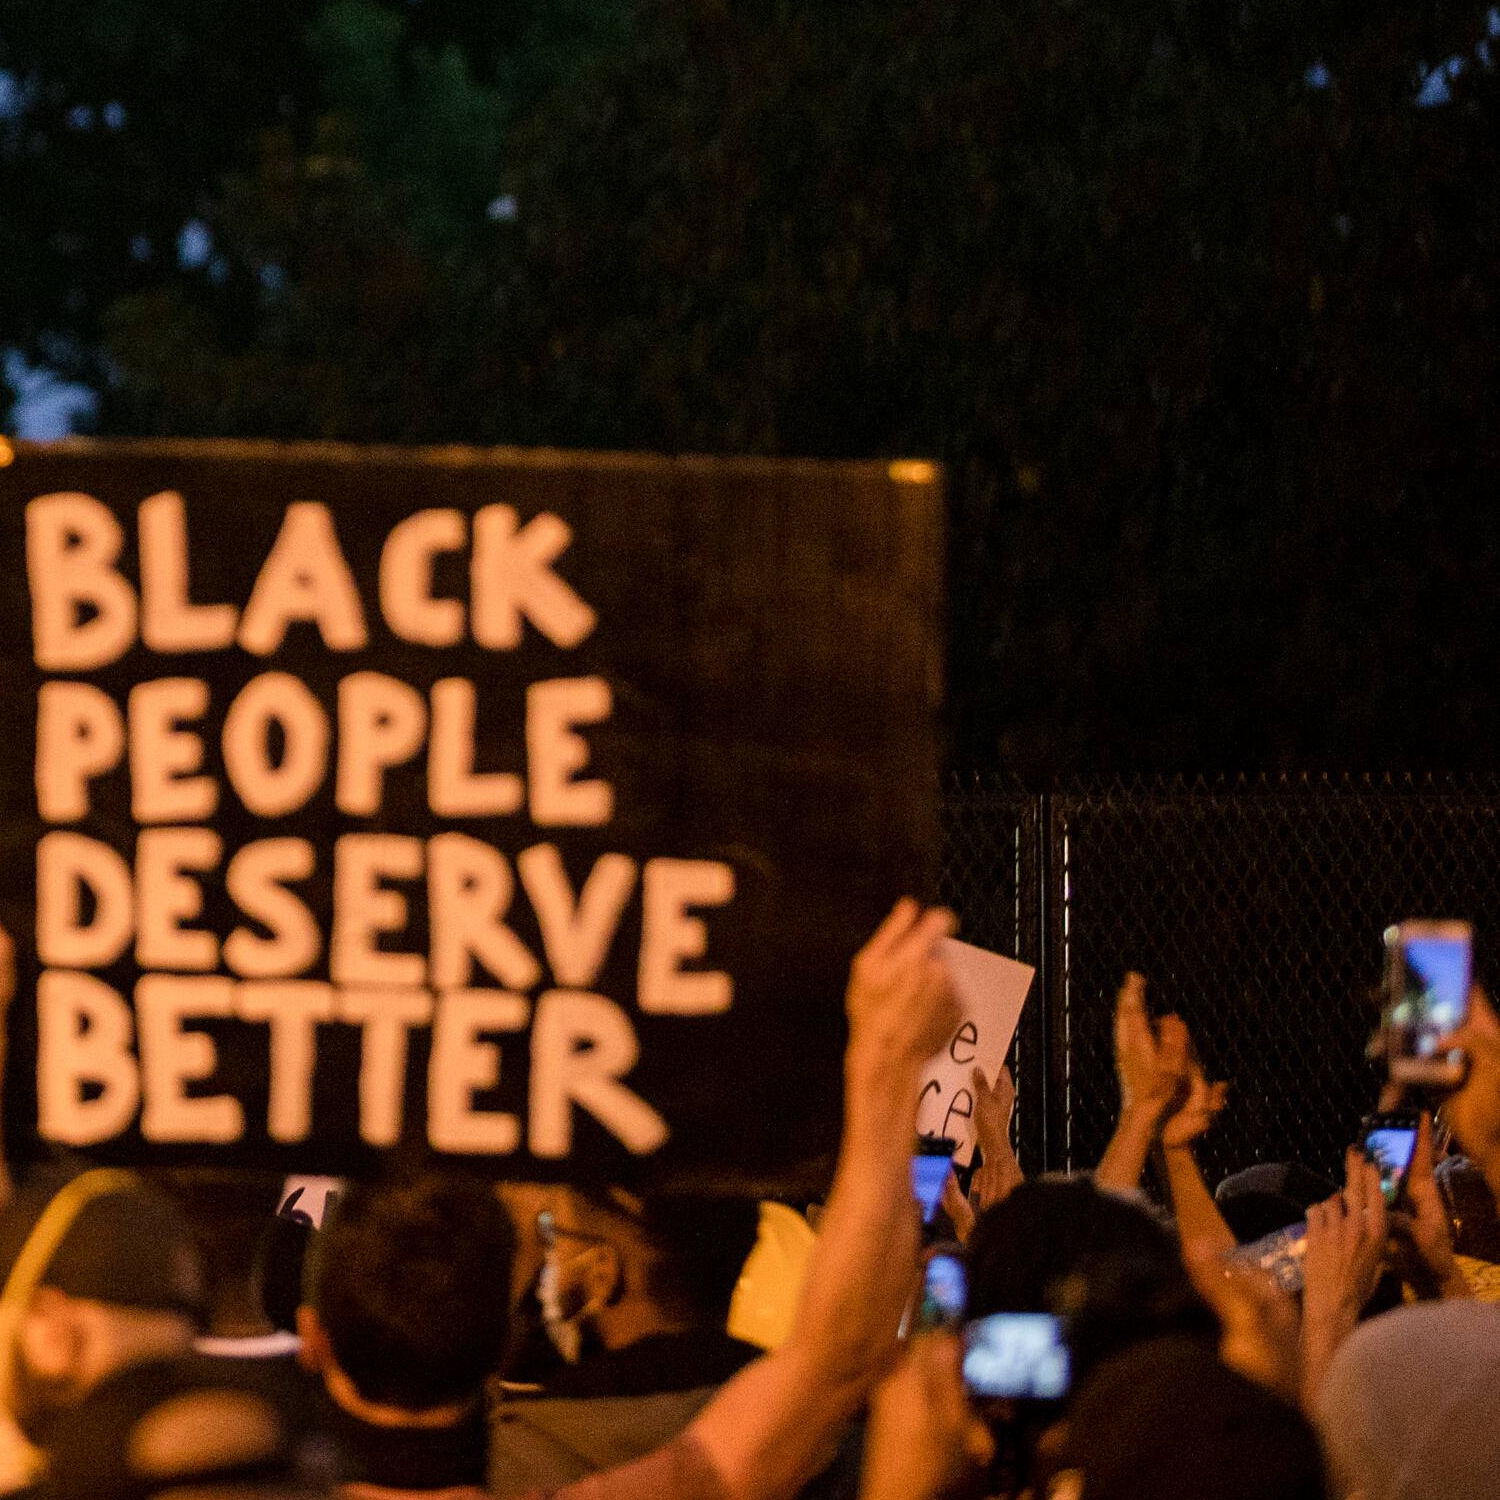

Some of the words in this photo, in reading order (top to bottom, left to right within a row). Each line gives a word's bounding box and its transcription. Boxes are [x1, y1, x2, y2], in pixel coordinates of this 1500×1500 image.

[24, 490, 598, 671] BLACK
[33, 670, 615, 827] PEOPLE
[33, 826, 736, 1016] DESERVE
[34, 969, 671, 1159] BETTER
